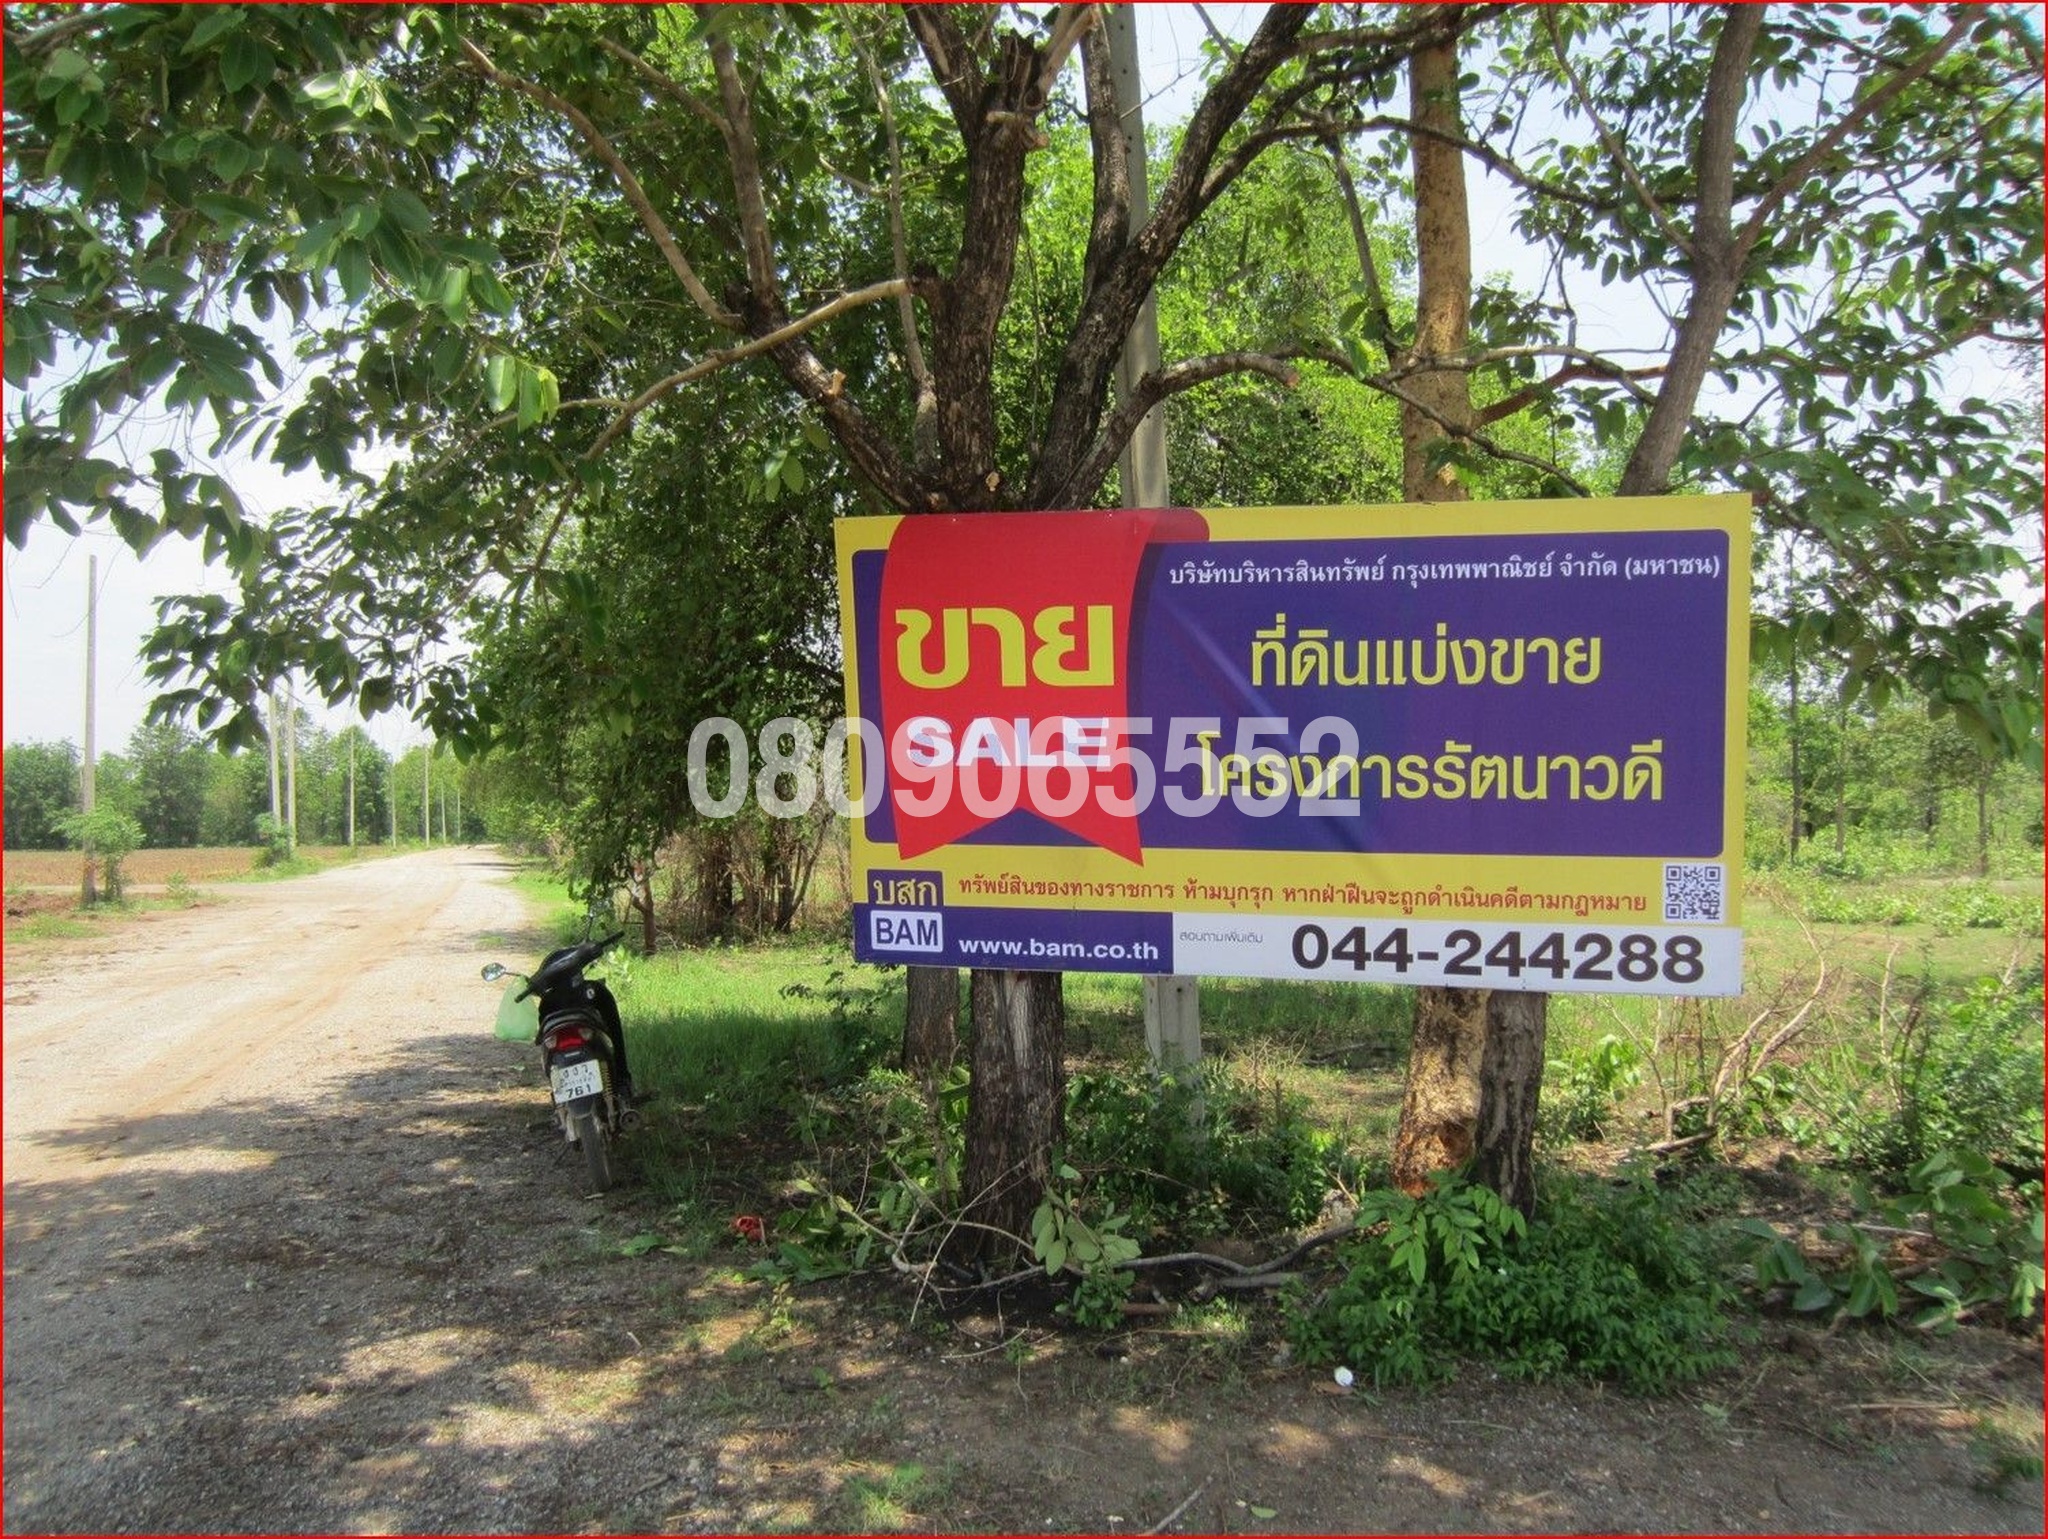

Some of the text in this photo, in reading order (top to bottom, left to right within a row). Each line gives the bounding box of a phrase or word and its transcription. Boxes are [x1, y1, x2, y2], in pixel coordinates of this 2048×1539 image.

[1169, 551, 1721, 589] บริษัทบริหารสินทรัพย์ กรุงเทพพาณิชย์ จำกัด (มหาชน)
[895, 605, 1115, 689] ขาย
[1250, 613, 1602, 688] ที่ดินแบ่งขาย
[906, 717, 1112, 768] SALE
[1196, 731, 1663, 802] โครงการรัตนาวดี
[873, 877, 938, 907] บสก
[959, 872, 1174, 899] ทรัพย์สินของทางราชการ
[1183, 878, 1273, 909] ห้ามบุกรุก
[876, 917, 938, 947] BAM
[958, 935, 1158, 961] www.bam.co.th
[1292, 924, 1705, 984] 044-244288
[565, 1083, 592, 1099] 761
